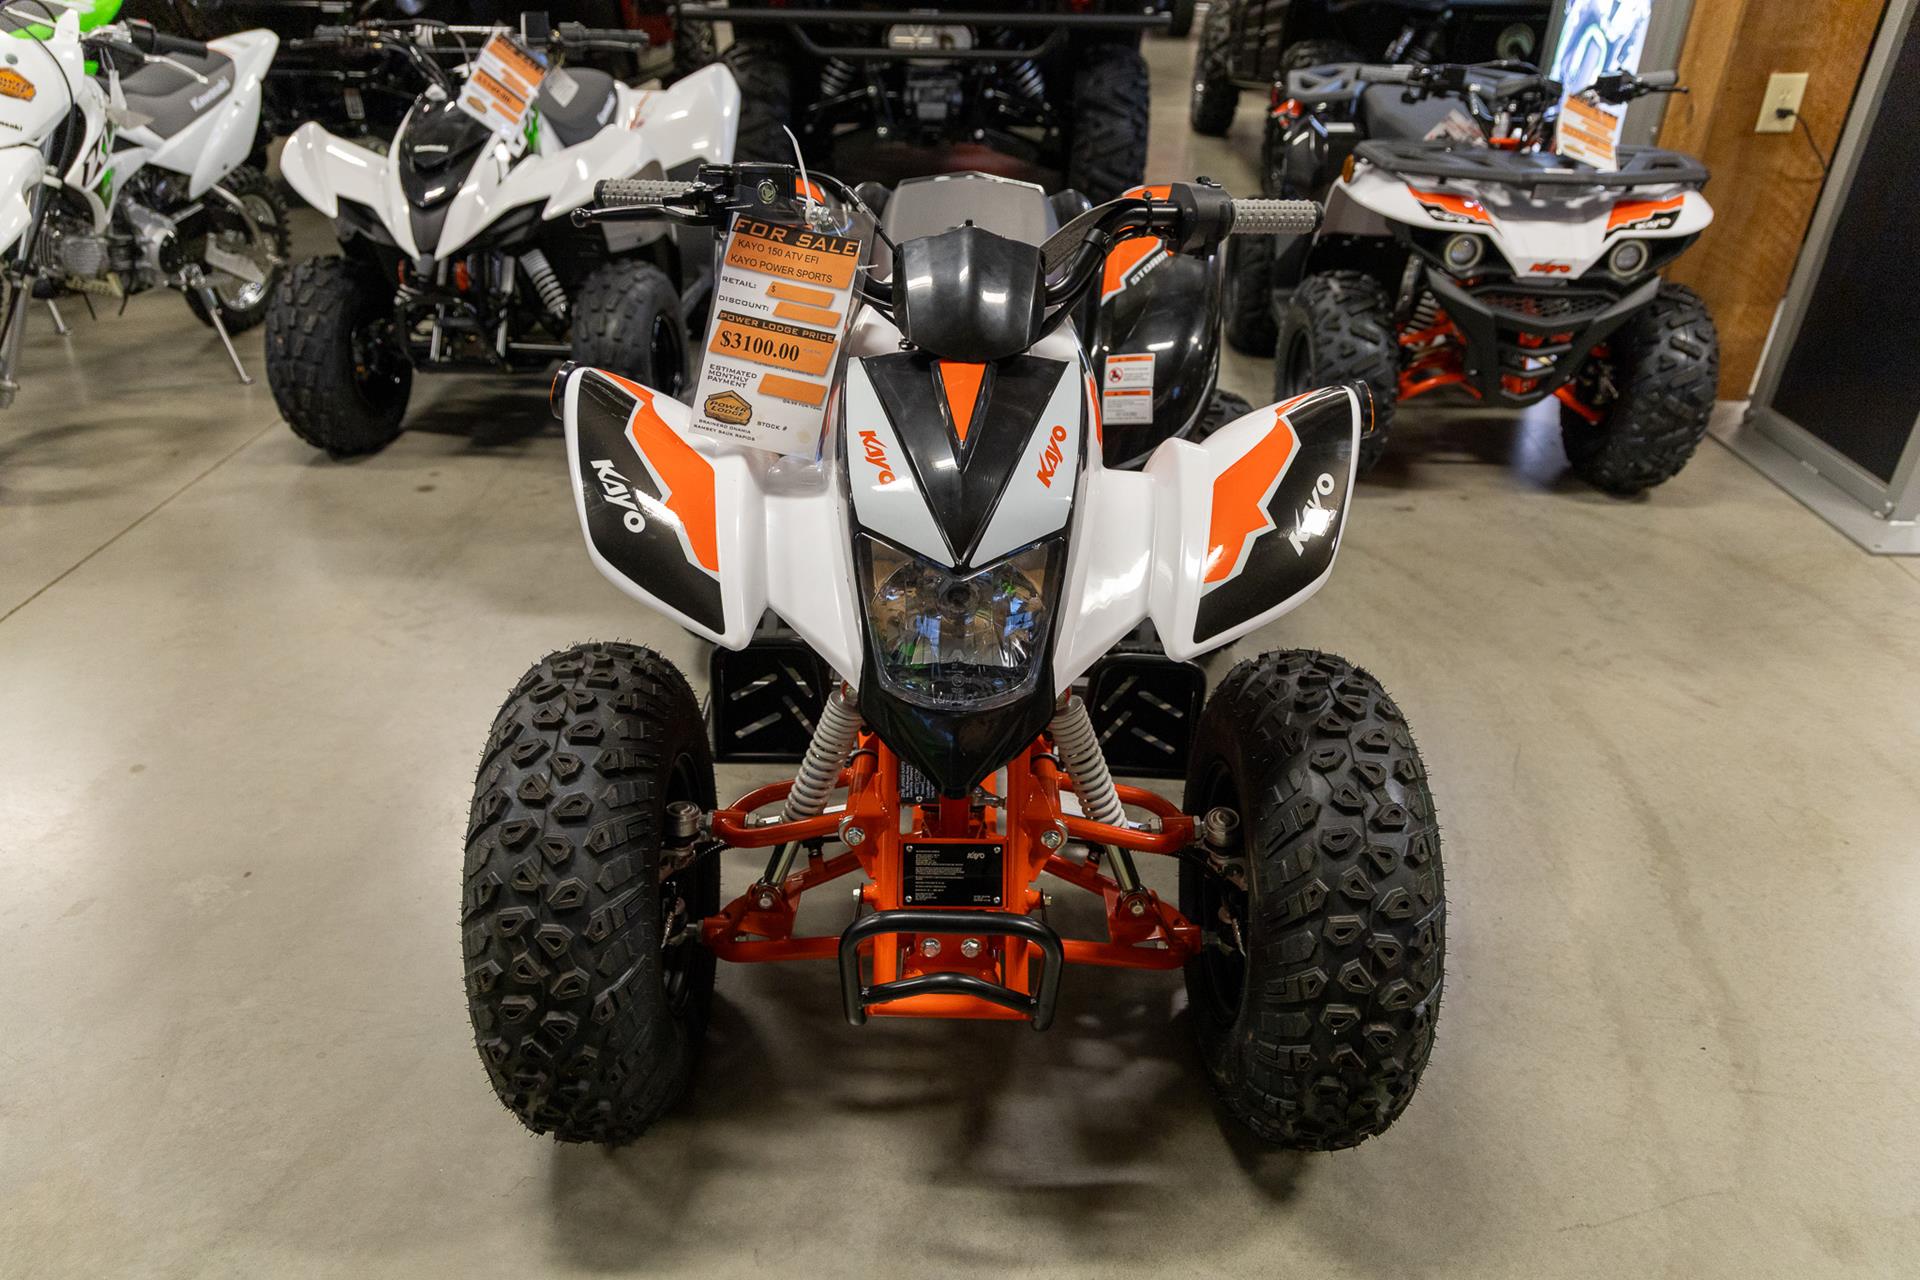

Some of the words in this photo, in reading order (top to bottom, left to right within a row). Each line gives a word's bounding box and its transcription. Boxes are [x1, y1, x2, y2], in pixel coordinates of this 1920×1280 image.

[734, 218, 788, 243] FOR
[795, 233, 859, 257] SALE
[737, 238, 765, 253] KAYO
[768, 246, 783, 257] 150
[784, 250, 805, 262] ATV
[804, 255, 819, 265] EFI
[730, 253, 758, 267] KAYO
[759, 261, 795, 276] POWER
[795, 268, 833, 284] SPORTS
[721, 275, 757, 289] RETAIL:
[718, 294, 770, 312] DISCOUNT:
[719, 311, 759, 328] POWER
[761, 321, 800, 337] LODGE
[801, 329, 834, 343] PRICE
[719, 329, 800, 362] $3100.00
[707, 370, 750, 383] MONTHLY
[708, 363, 758, 380] ESTIMATED
[706, 375, 748, 389] PAYMENT
[709, 399, 747, 413] POWER
[711, 405, 744, 417] LODGE
[756, 420, 781, 431] STOCK
